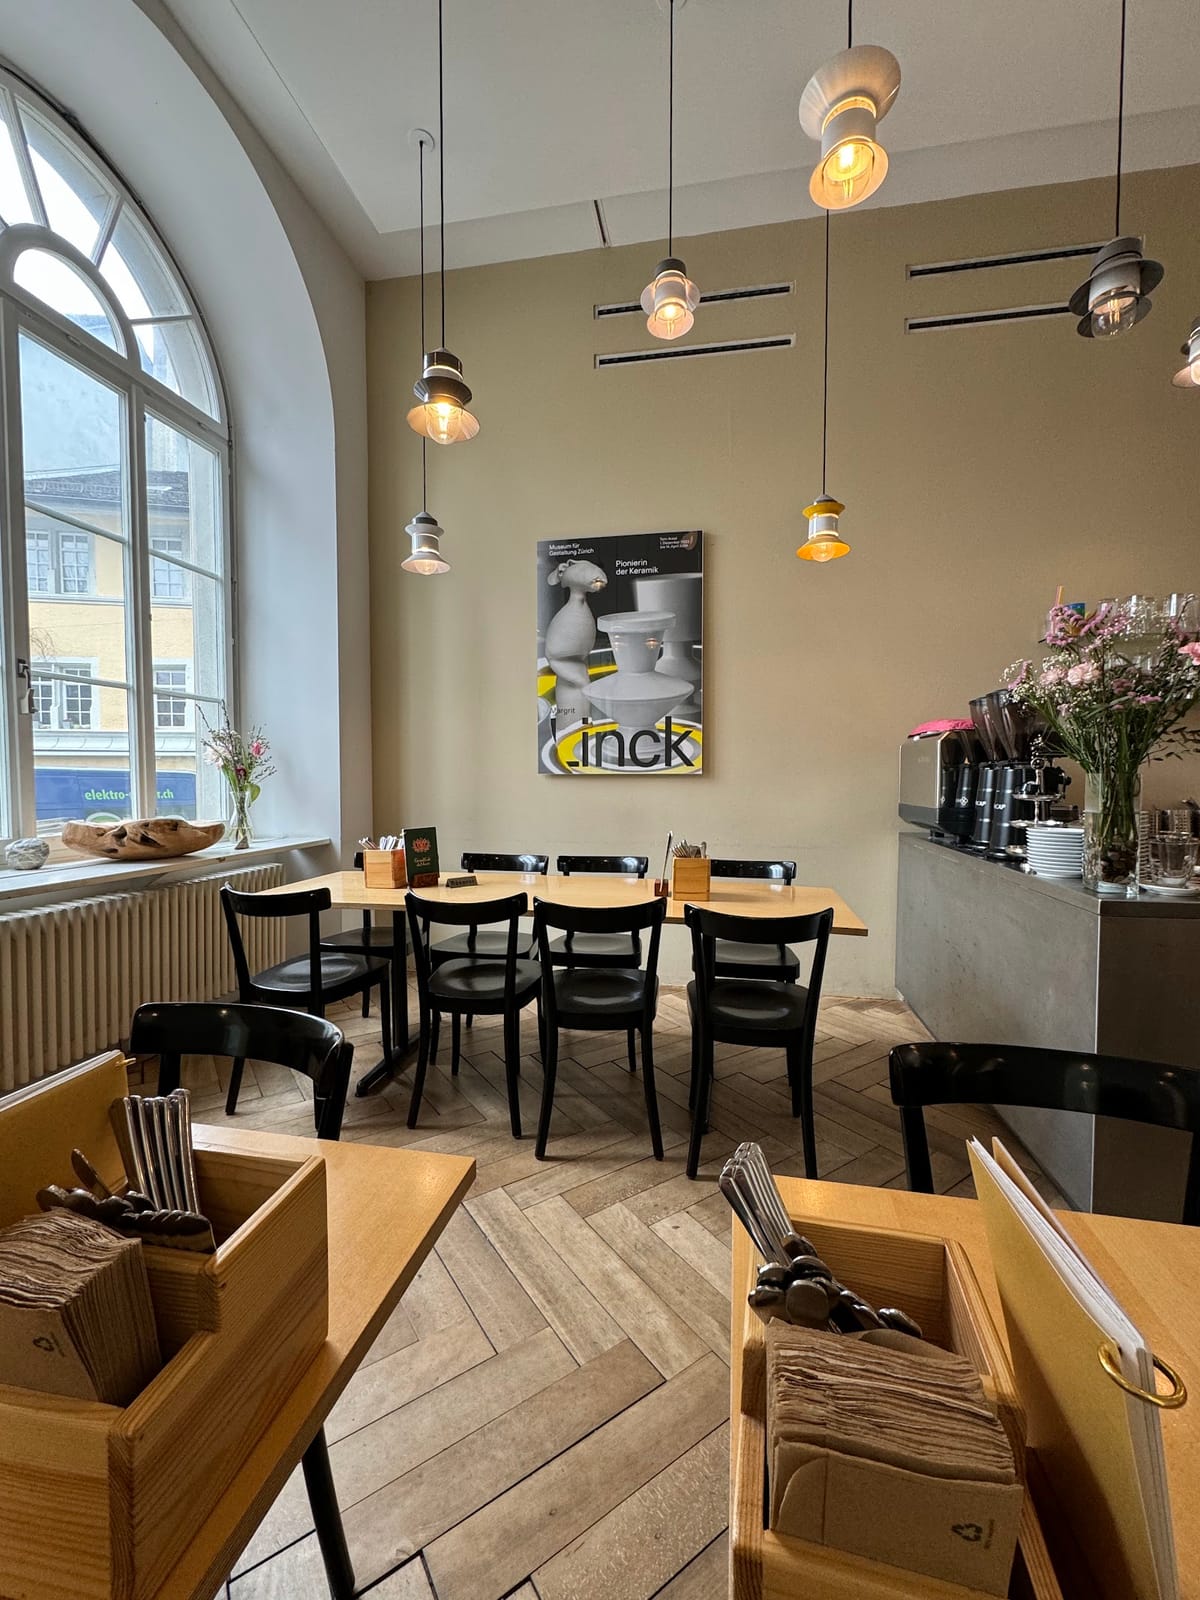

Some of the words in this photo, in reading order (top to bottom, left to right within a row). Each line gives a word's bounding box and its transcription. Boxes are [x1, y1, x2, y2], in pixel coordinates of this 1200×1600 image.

[615, 558, 648, 567] Pionierin
[615, 567, 628, 576] der
[629, 566, 659, 575] Keramik
